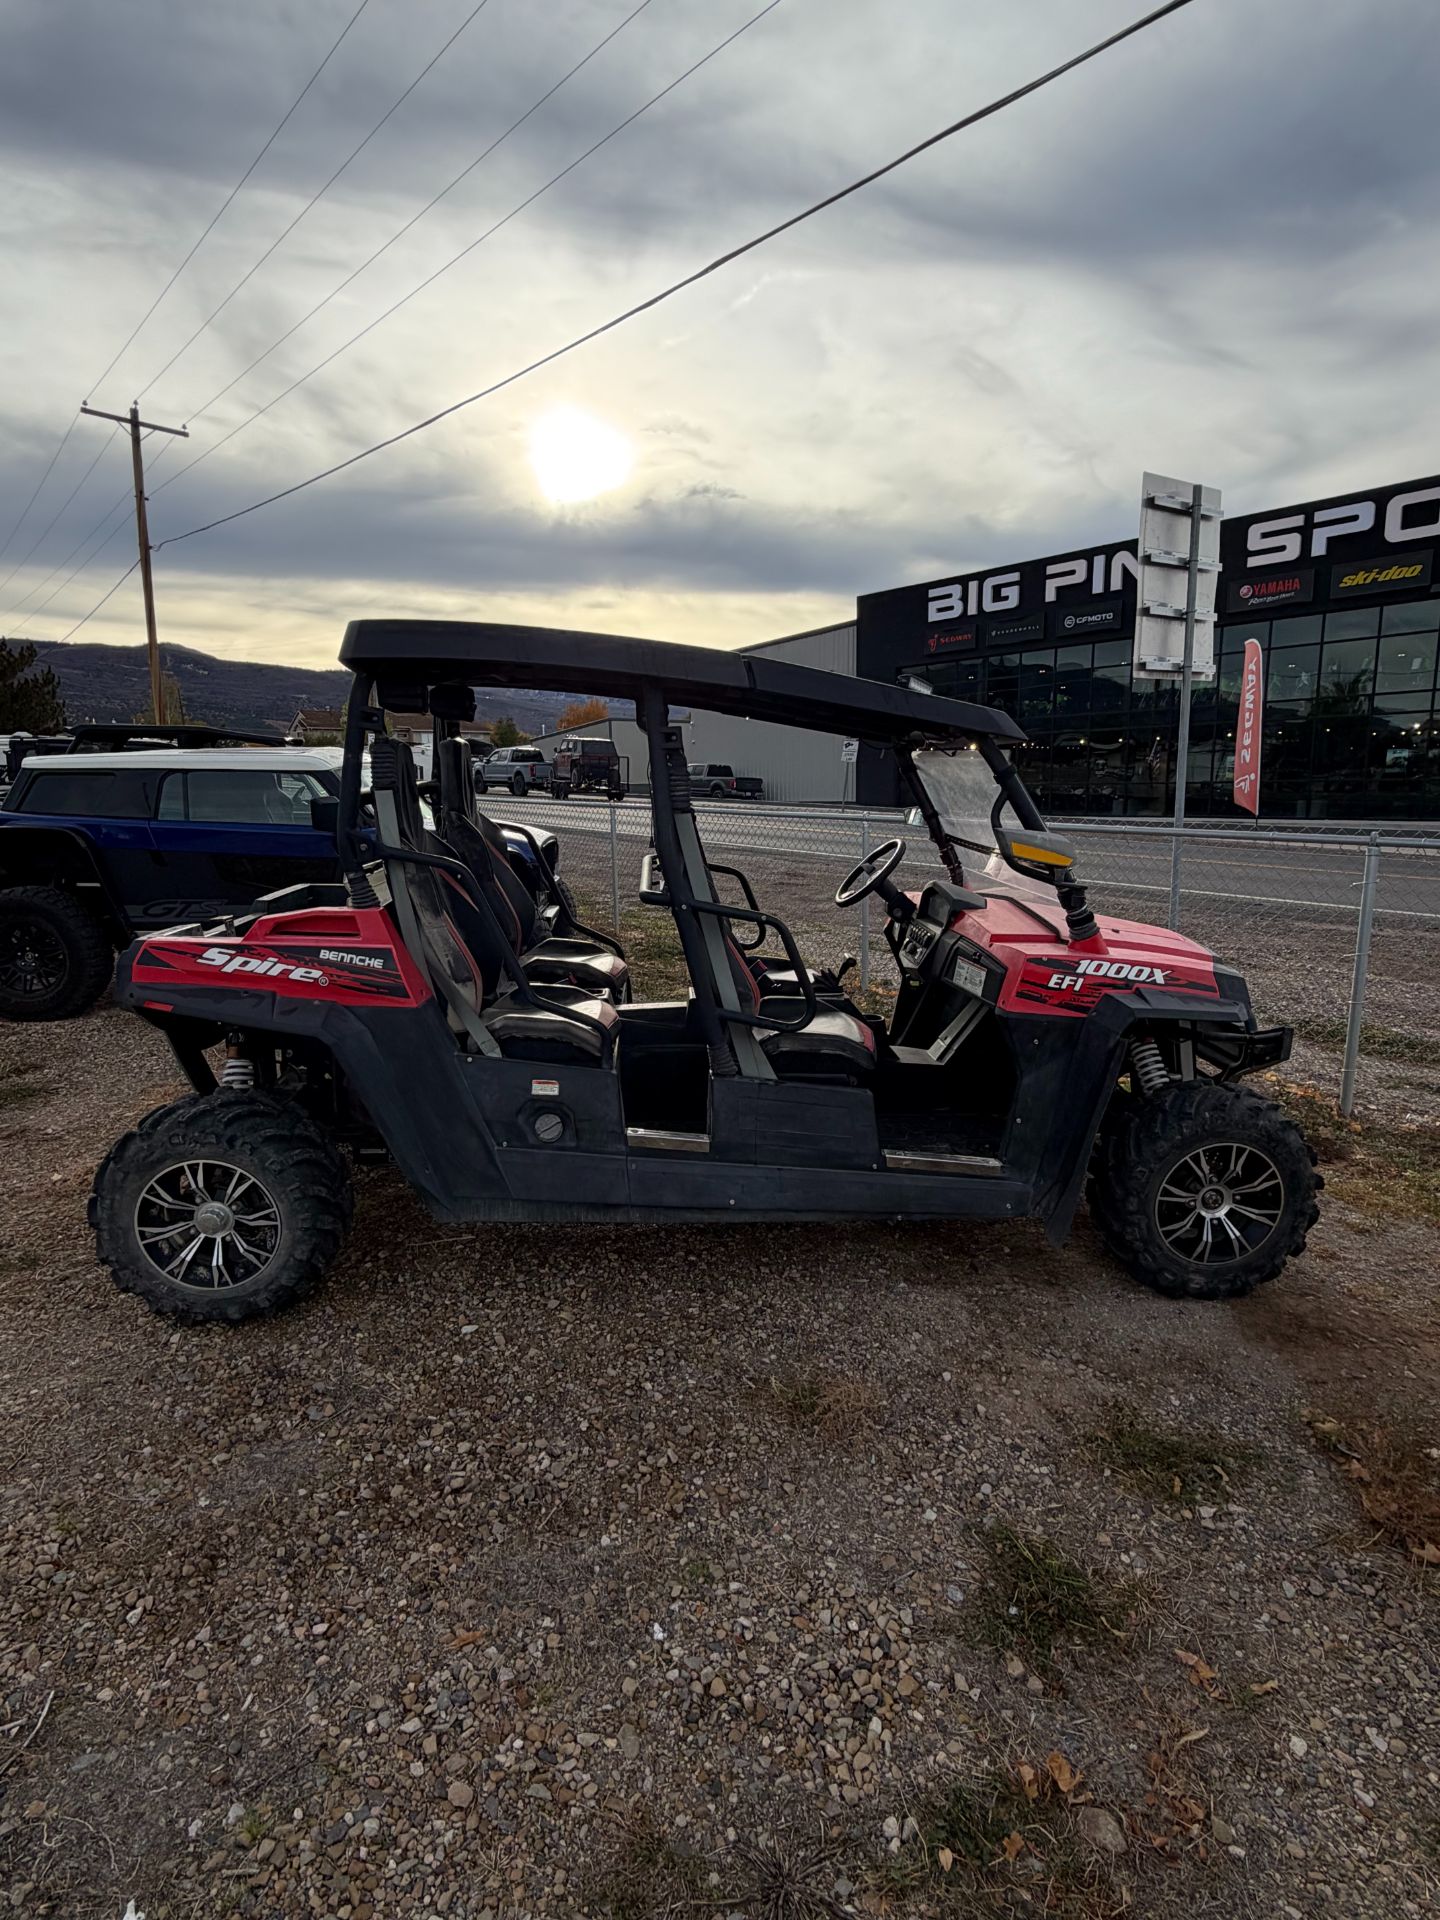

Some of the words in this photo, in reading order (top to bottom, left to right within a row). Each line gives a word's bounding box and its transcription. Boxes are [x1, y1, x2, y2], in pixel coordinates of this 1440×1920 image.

[1339, 564, 1424, 587] ski-doo
[928, 571, 1020, 622] BIG
[1253, 578, 1301, 595] YAMAHA
[1076, 612, 1113, 624] CFMOTO
[319, 949, 385, 969] BENNCHE
[1075, 959, 1172, 984] 1000X
[1048, 974, 1084, 992] EFI
